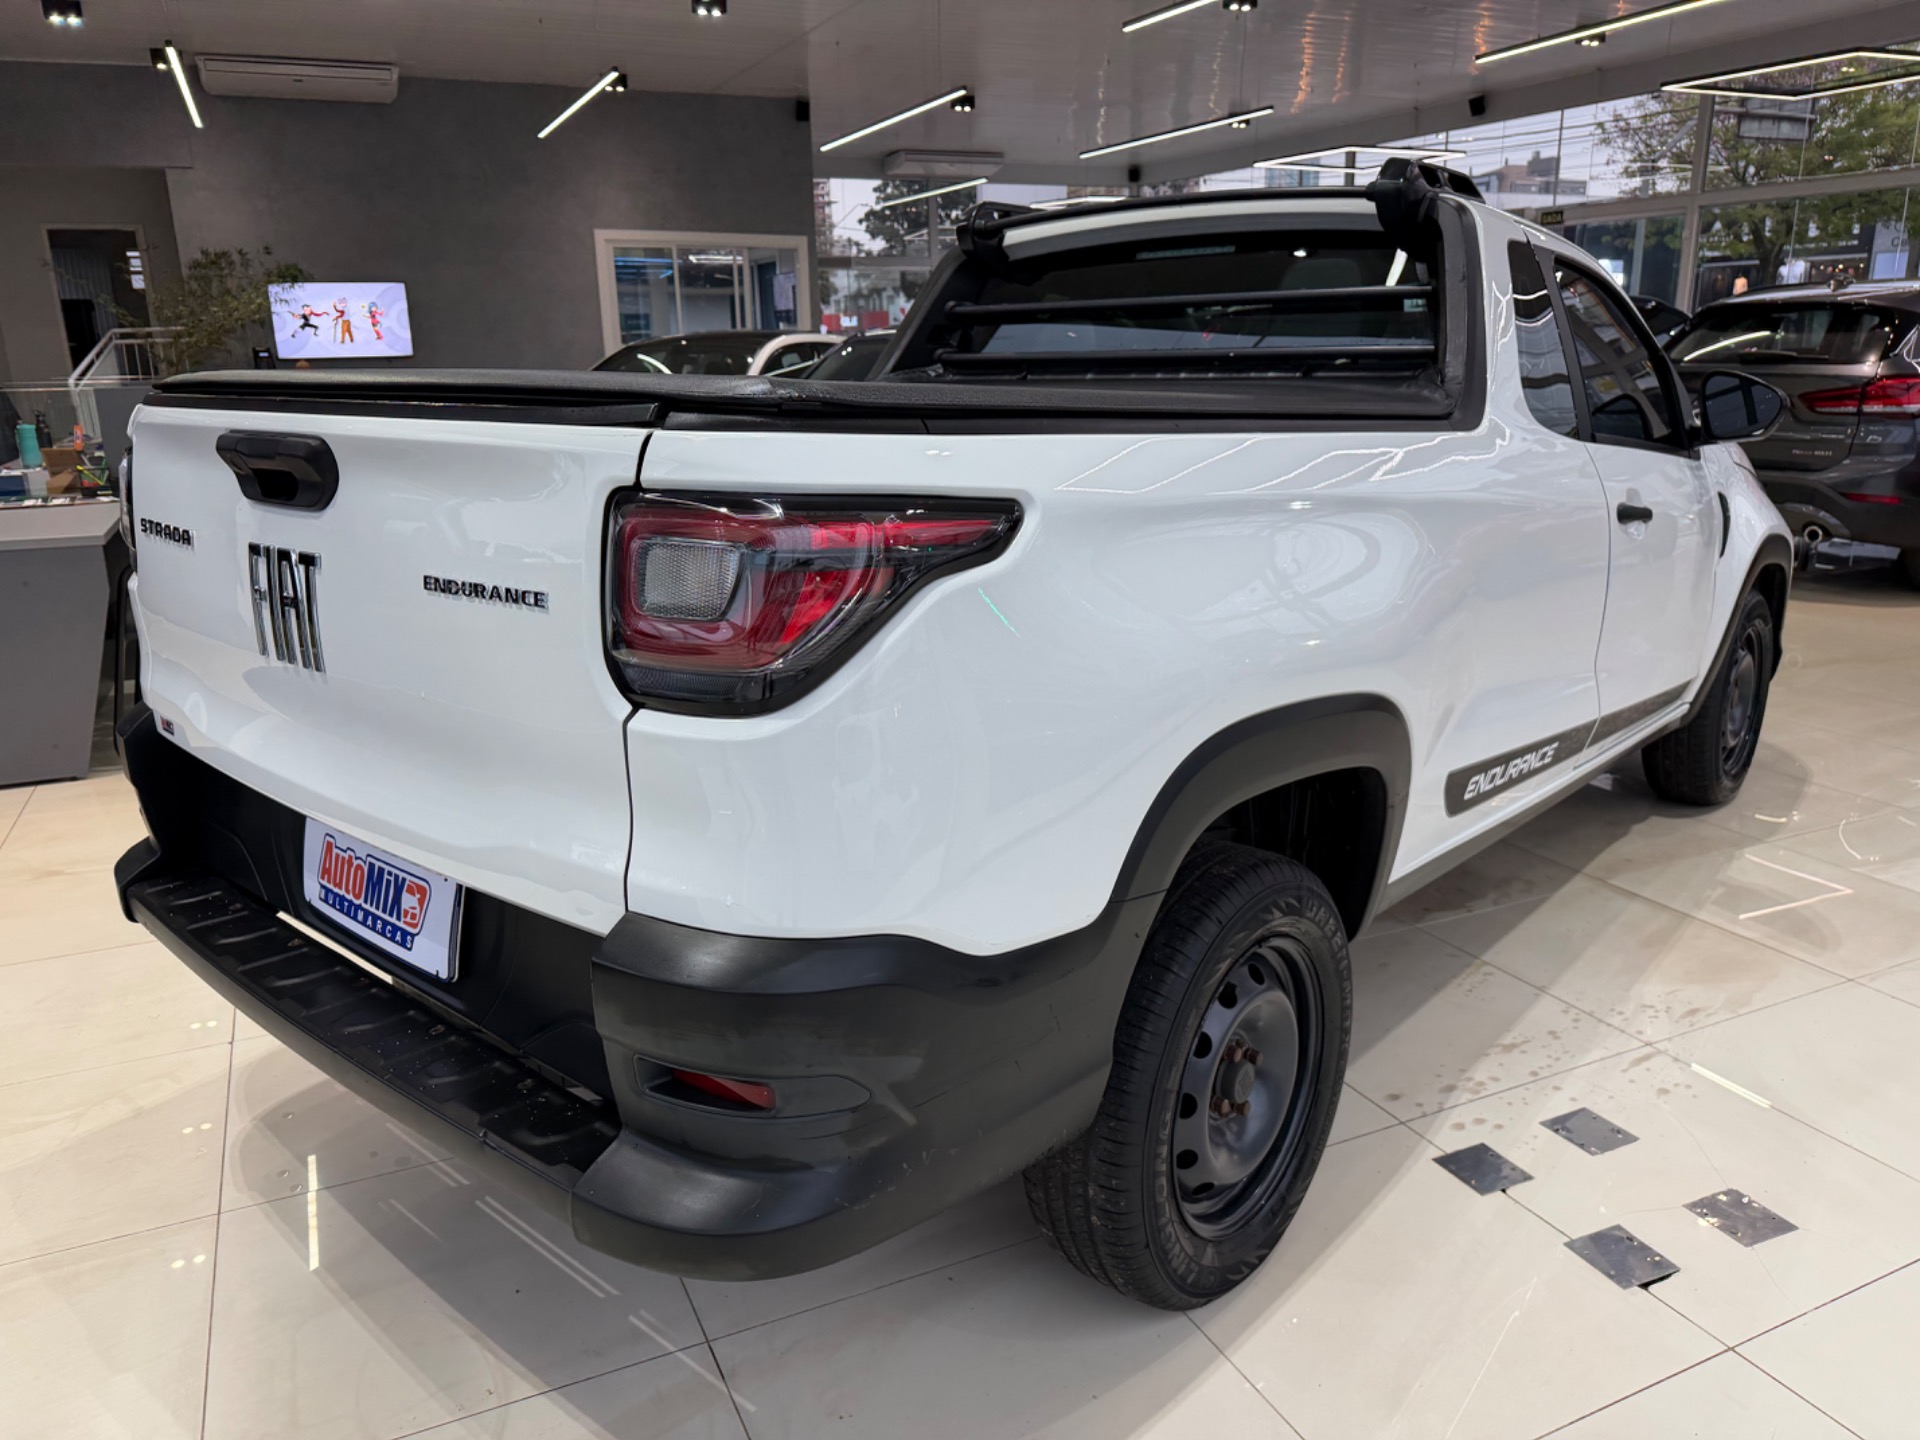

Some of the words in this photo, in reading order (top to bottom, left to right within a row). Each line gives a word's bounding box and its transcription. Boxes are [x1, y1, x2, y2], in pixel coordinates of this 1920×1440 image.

[140, 516, 193, 548] STRADA
[248, 541, 327, 673] FIAT
[422, 573, 549, 611] ENDURANCE
[1463, 740, 1560, 801] ENDURANCE
[319, 888, 414, 949] MULTIMARCAS
